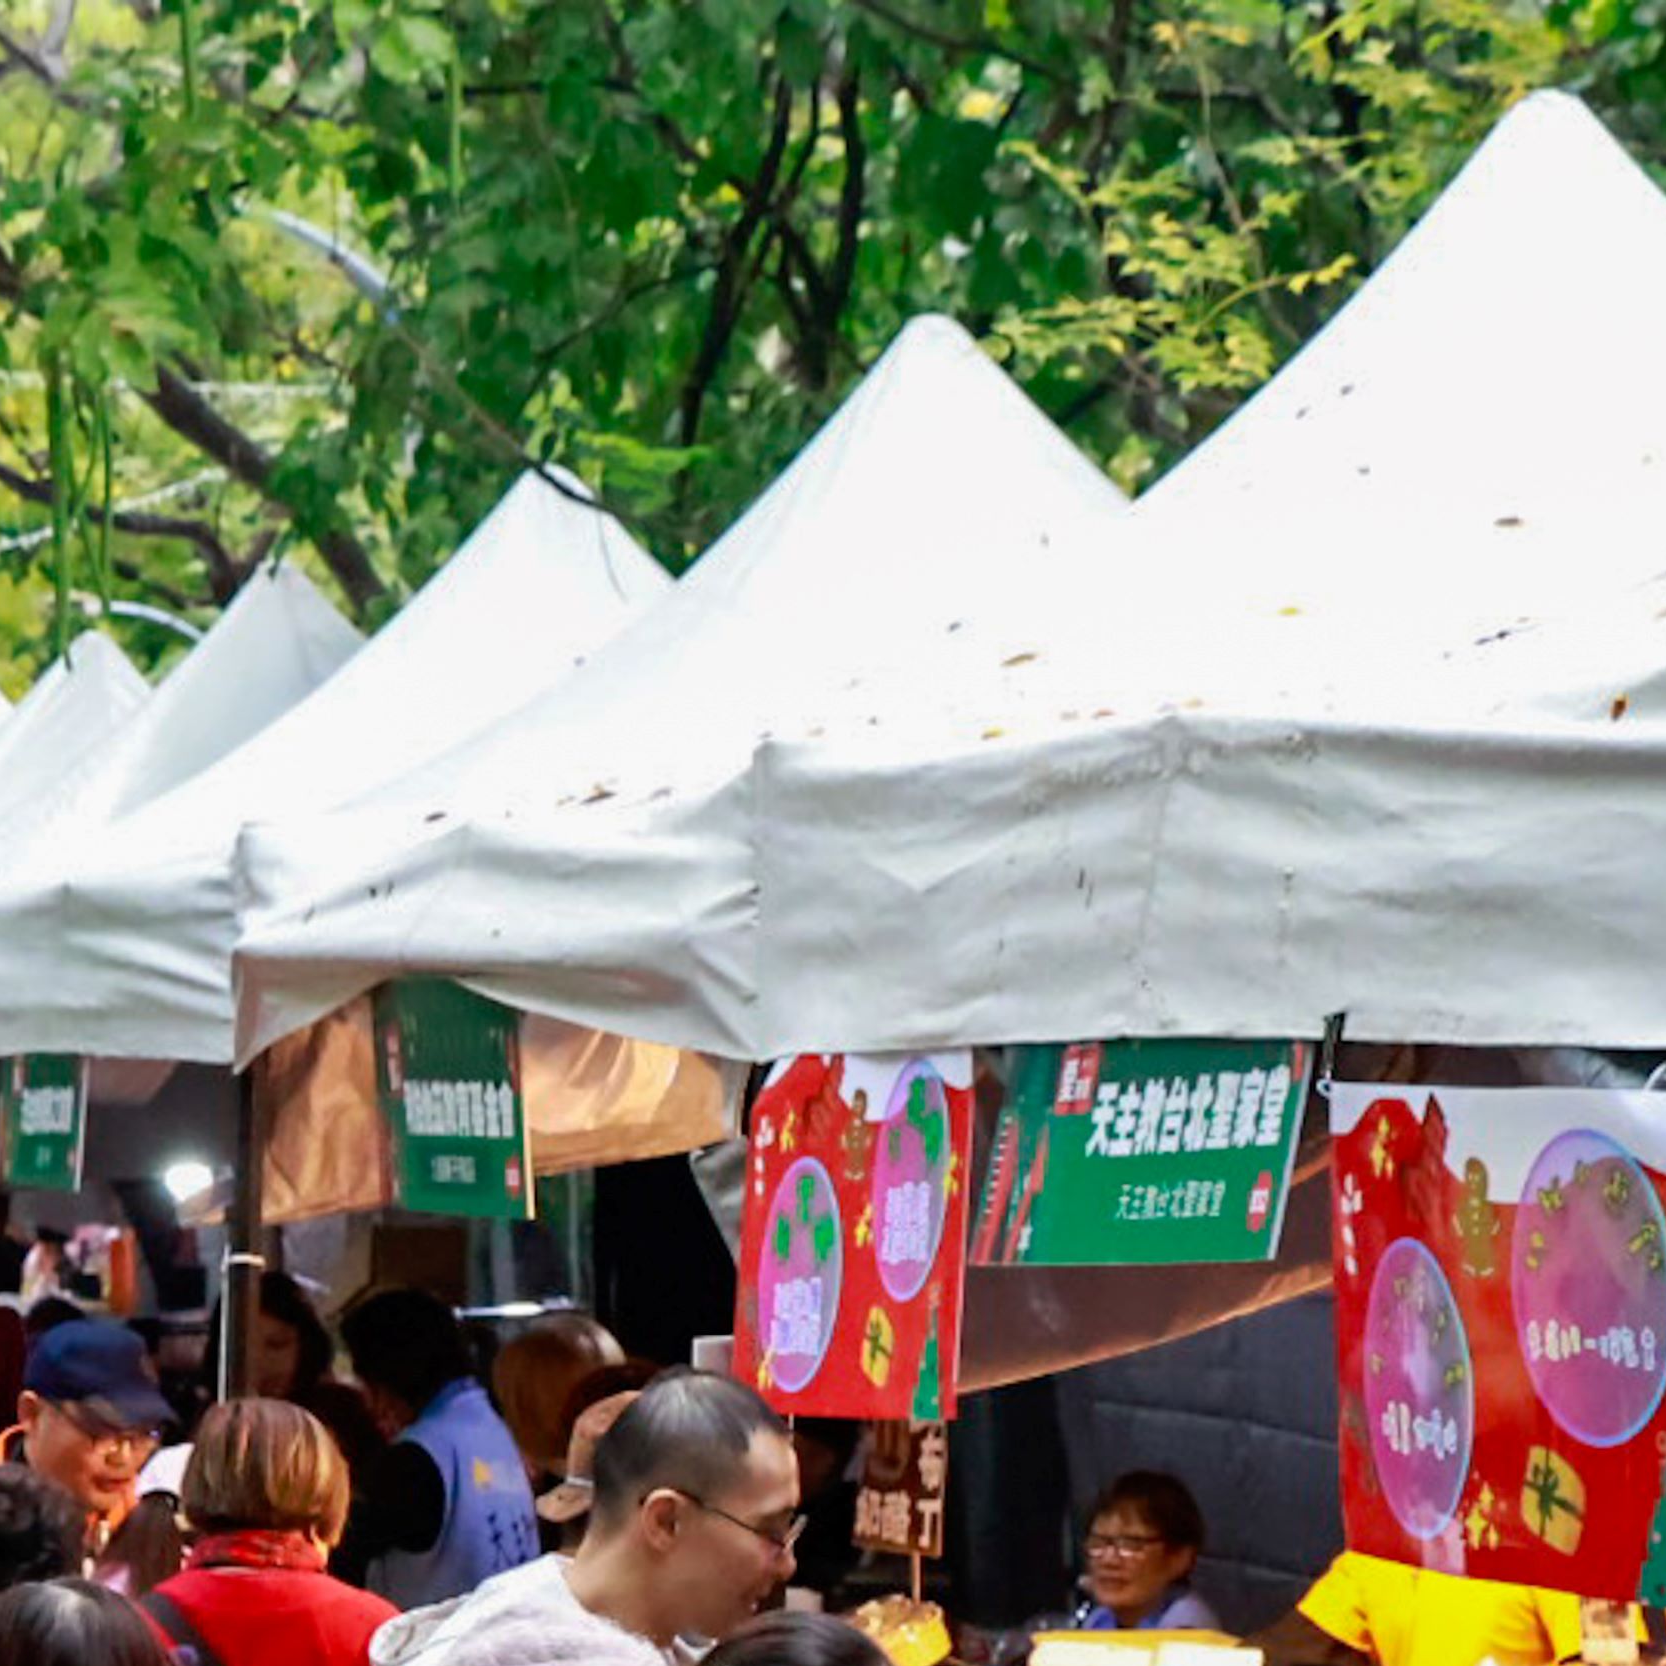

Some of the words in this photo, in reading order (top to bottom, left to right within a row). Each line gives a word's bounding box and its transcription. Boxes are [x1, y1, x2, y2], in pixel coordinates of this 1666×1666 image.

[1085, 1064, 1291, 1157] 天主教台北聖家堂
